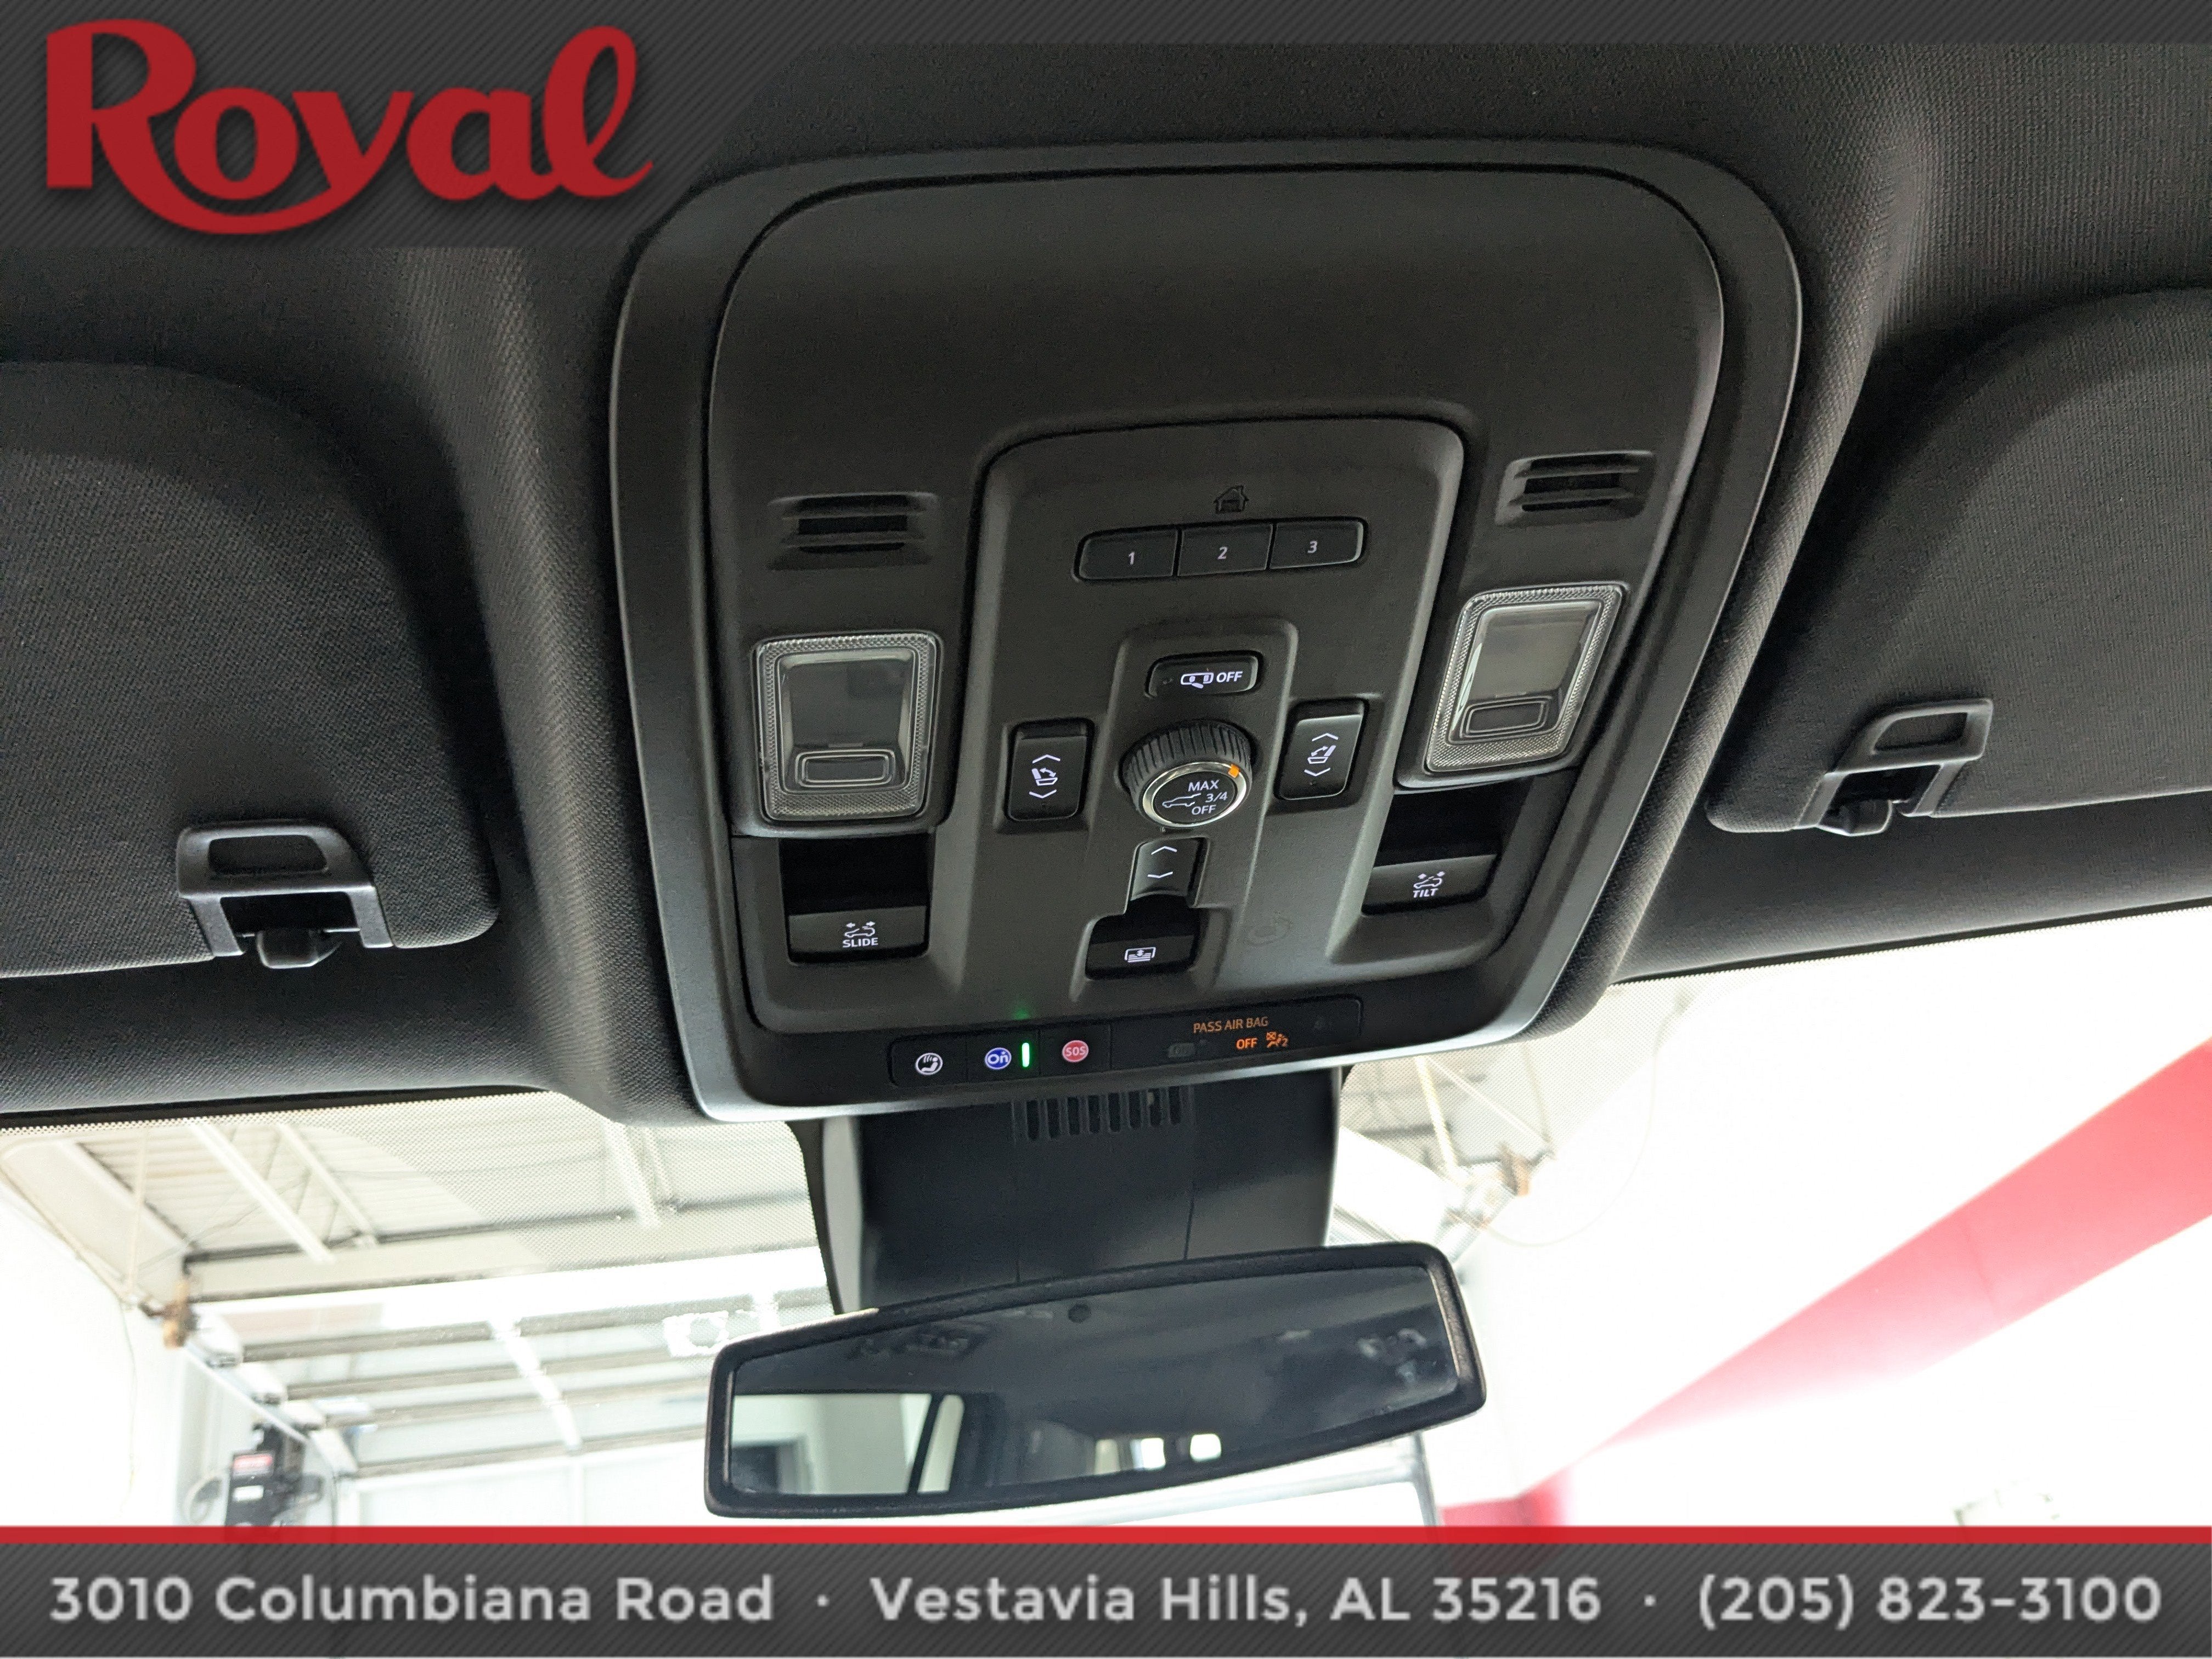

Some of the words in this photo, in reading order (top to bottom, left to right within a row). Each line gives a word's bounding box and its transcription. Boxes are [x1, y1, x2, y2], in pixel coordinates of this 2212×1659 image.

[1217, 546, 1228, 560] 2
[1307, 540, 1318, 554] 3
[1127, 552, 1135, 565] 1
[1216, 671, 1243, 684] OFF
[1188, 780, 1220, 792] MAX
[1205, 792, 1228, 802] 3/4
[1192, 804, 1216, 815] OFF
[1413, 888, 1438, 897] TILT
[843, 937, 879, 948] SLIDE
[1193, 1022, 1222, 1034] PASS
[1224, 1018, 1243, 1030] AIR
[1246, 1016, 1269, 1028] BAG
[1235, 1037, 1258, 1050] OFF
[988, 1050, 1009, 1064] On
[1065, 1046, 1086, 1057] SOS
